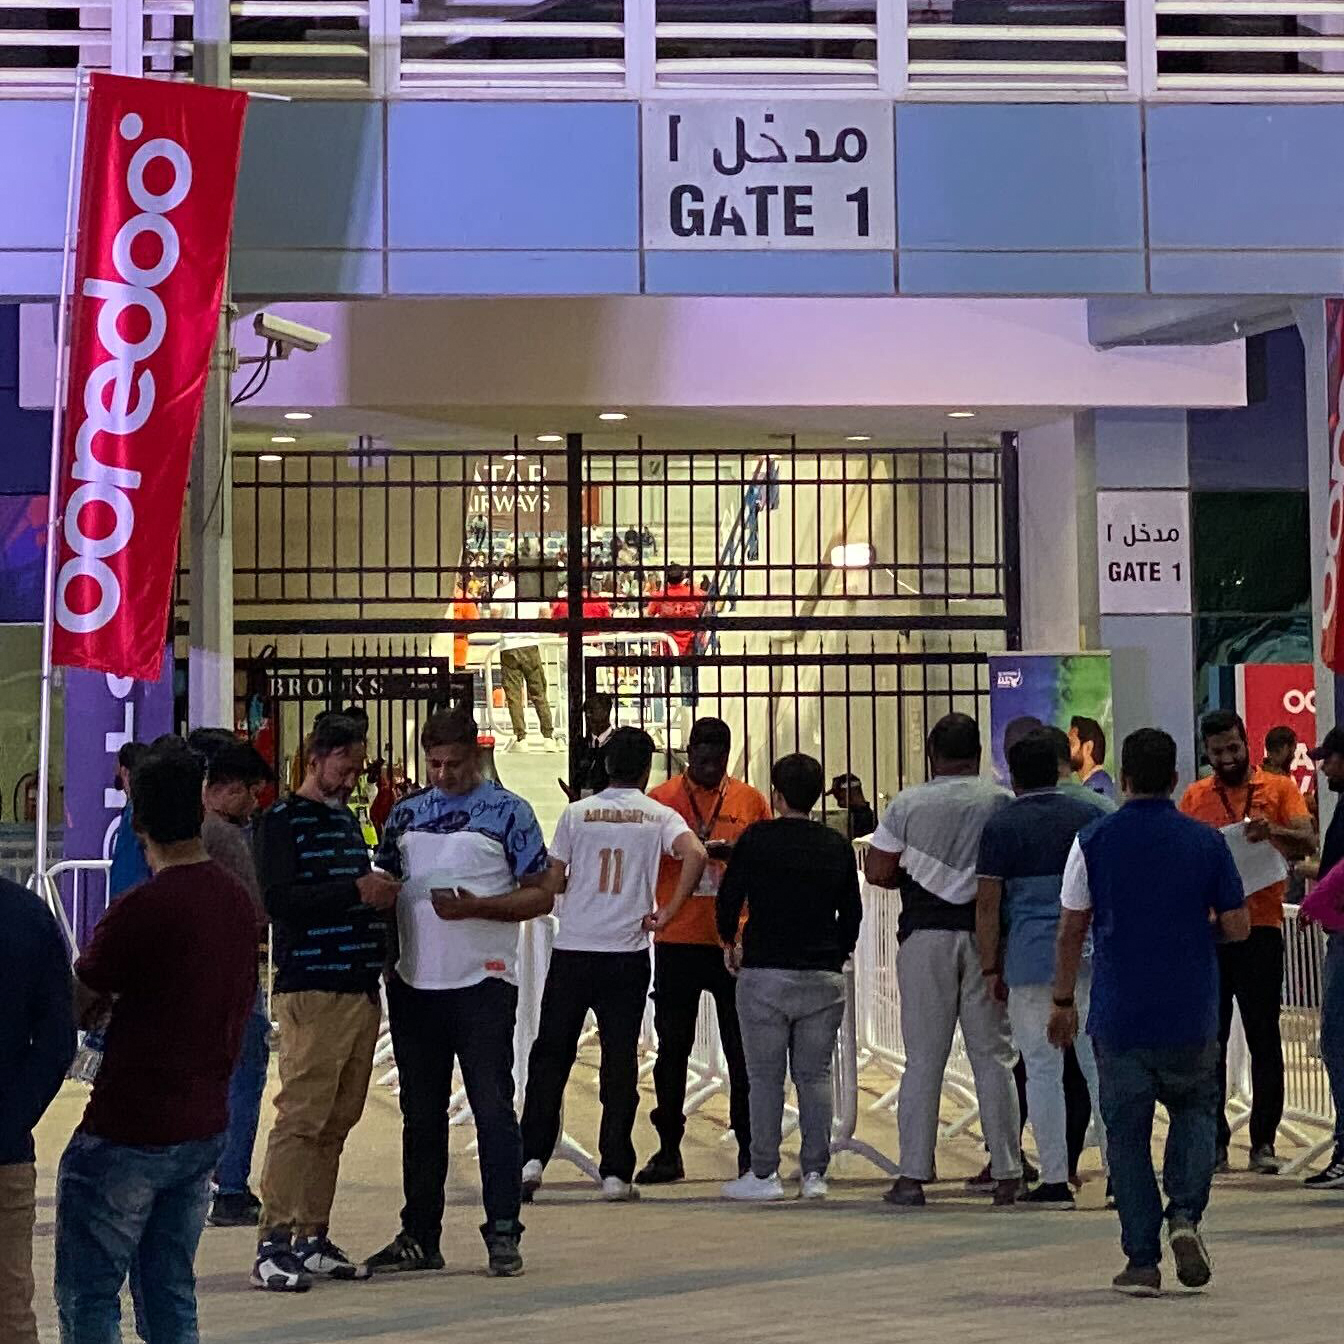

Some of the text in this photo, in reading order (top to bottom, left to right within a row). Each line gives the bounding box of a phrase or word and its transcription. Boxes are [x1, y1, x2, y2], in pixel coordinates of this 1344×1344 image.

[712, 113, 868, 176] مدخل
[669, 184, 870, 237] GATE 1
[56, 136, 193, 634] ooredoo
[468, 494, 551, 513] IRWAYS
[1123, 523, 1180, 547] مدخل
[1108, 561, 1181, 582] GATE 1
[270, 677, 384, 698] BROKS
